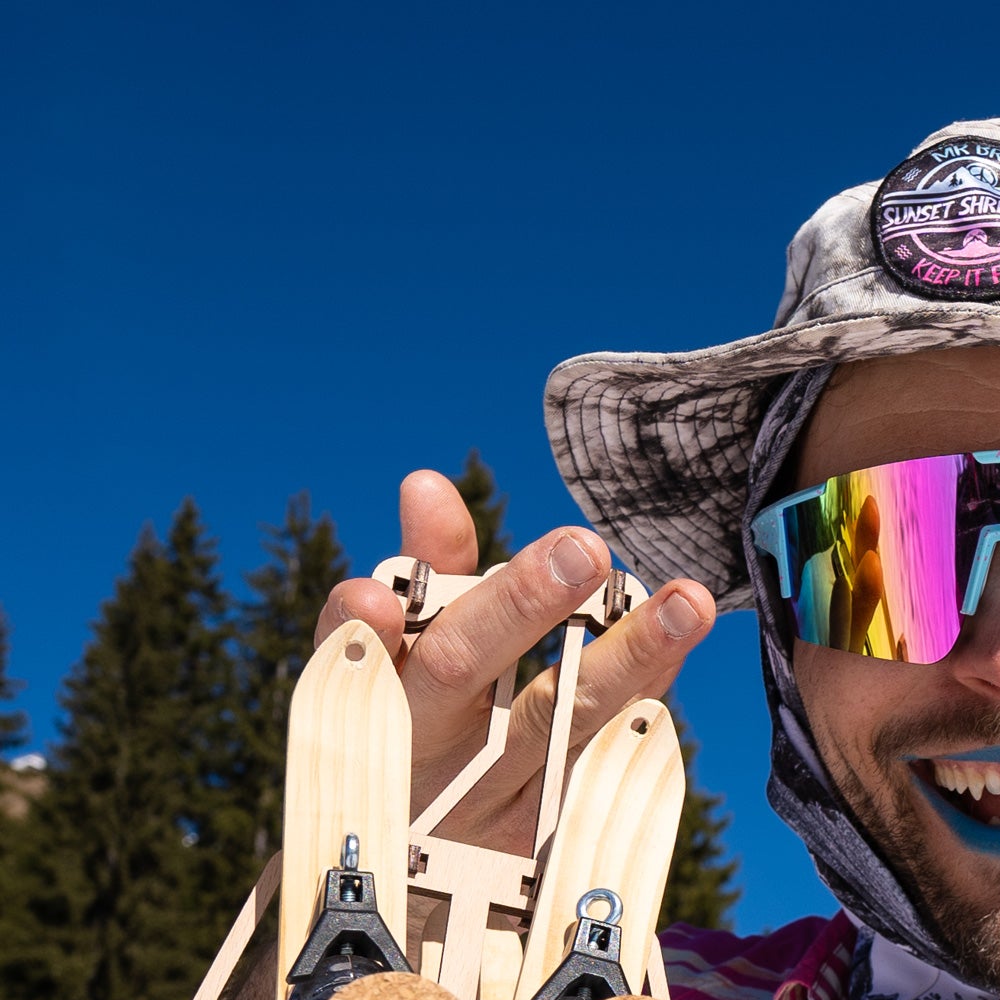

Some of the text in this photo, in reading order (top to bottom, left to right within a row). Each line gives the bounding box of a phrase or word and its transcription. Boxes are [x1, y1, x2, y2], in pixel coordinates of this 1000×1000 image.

[883, 200, 955, 228] SUNSET
[911, 257, 961, 285] KEEP
[964, 268, 982, 287] IT
